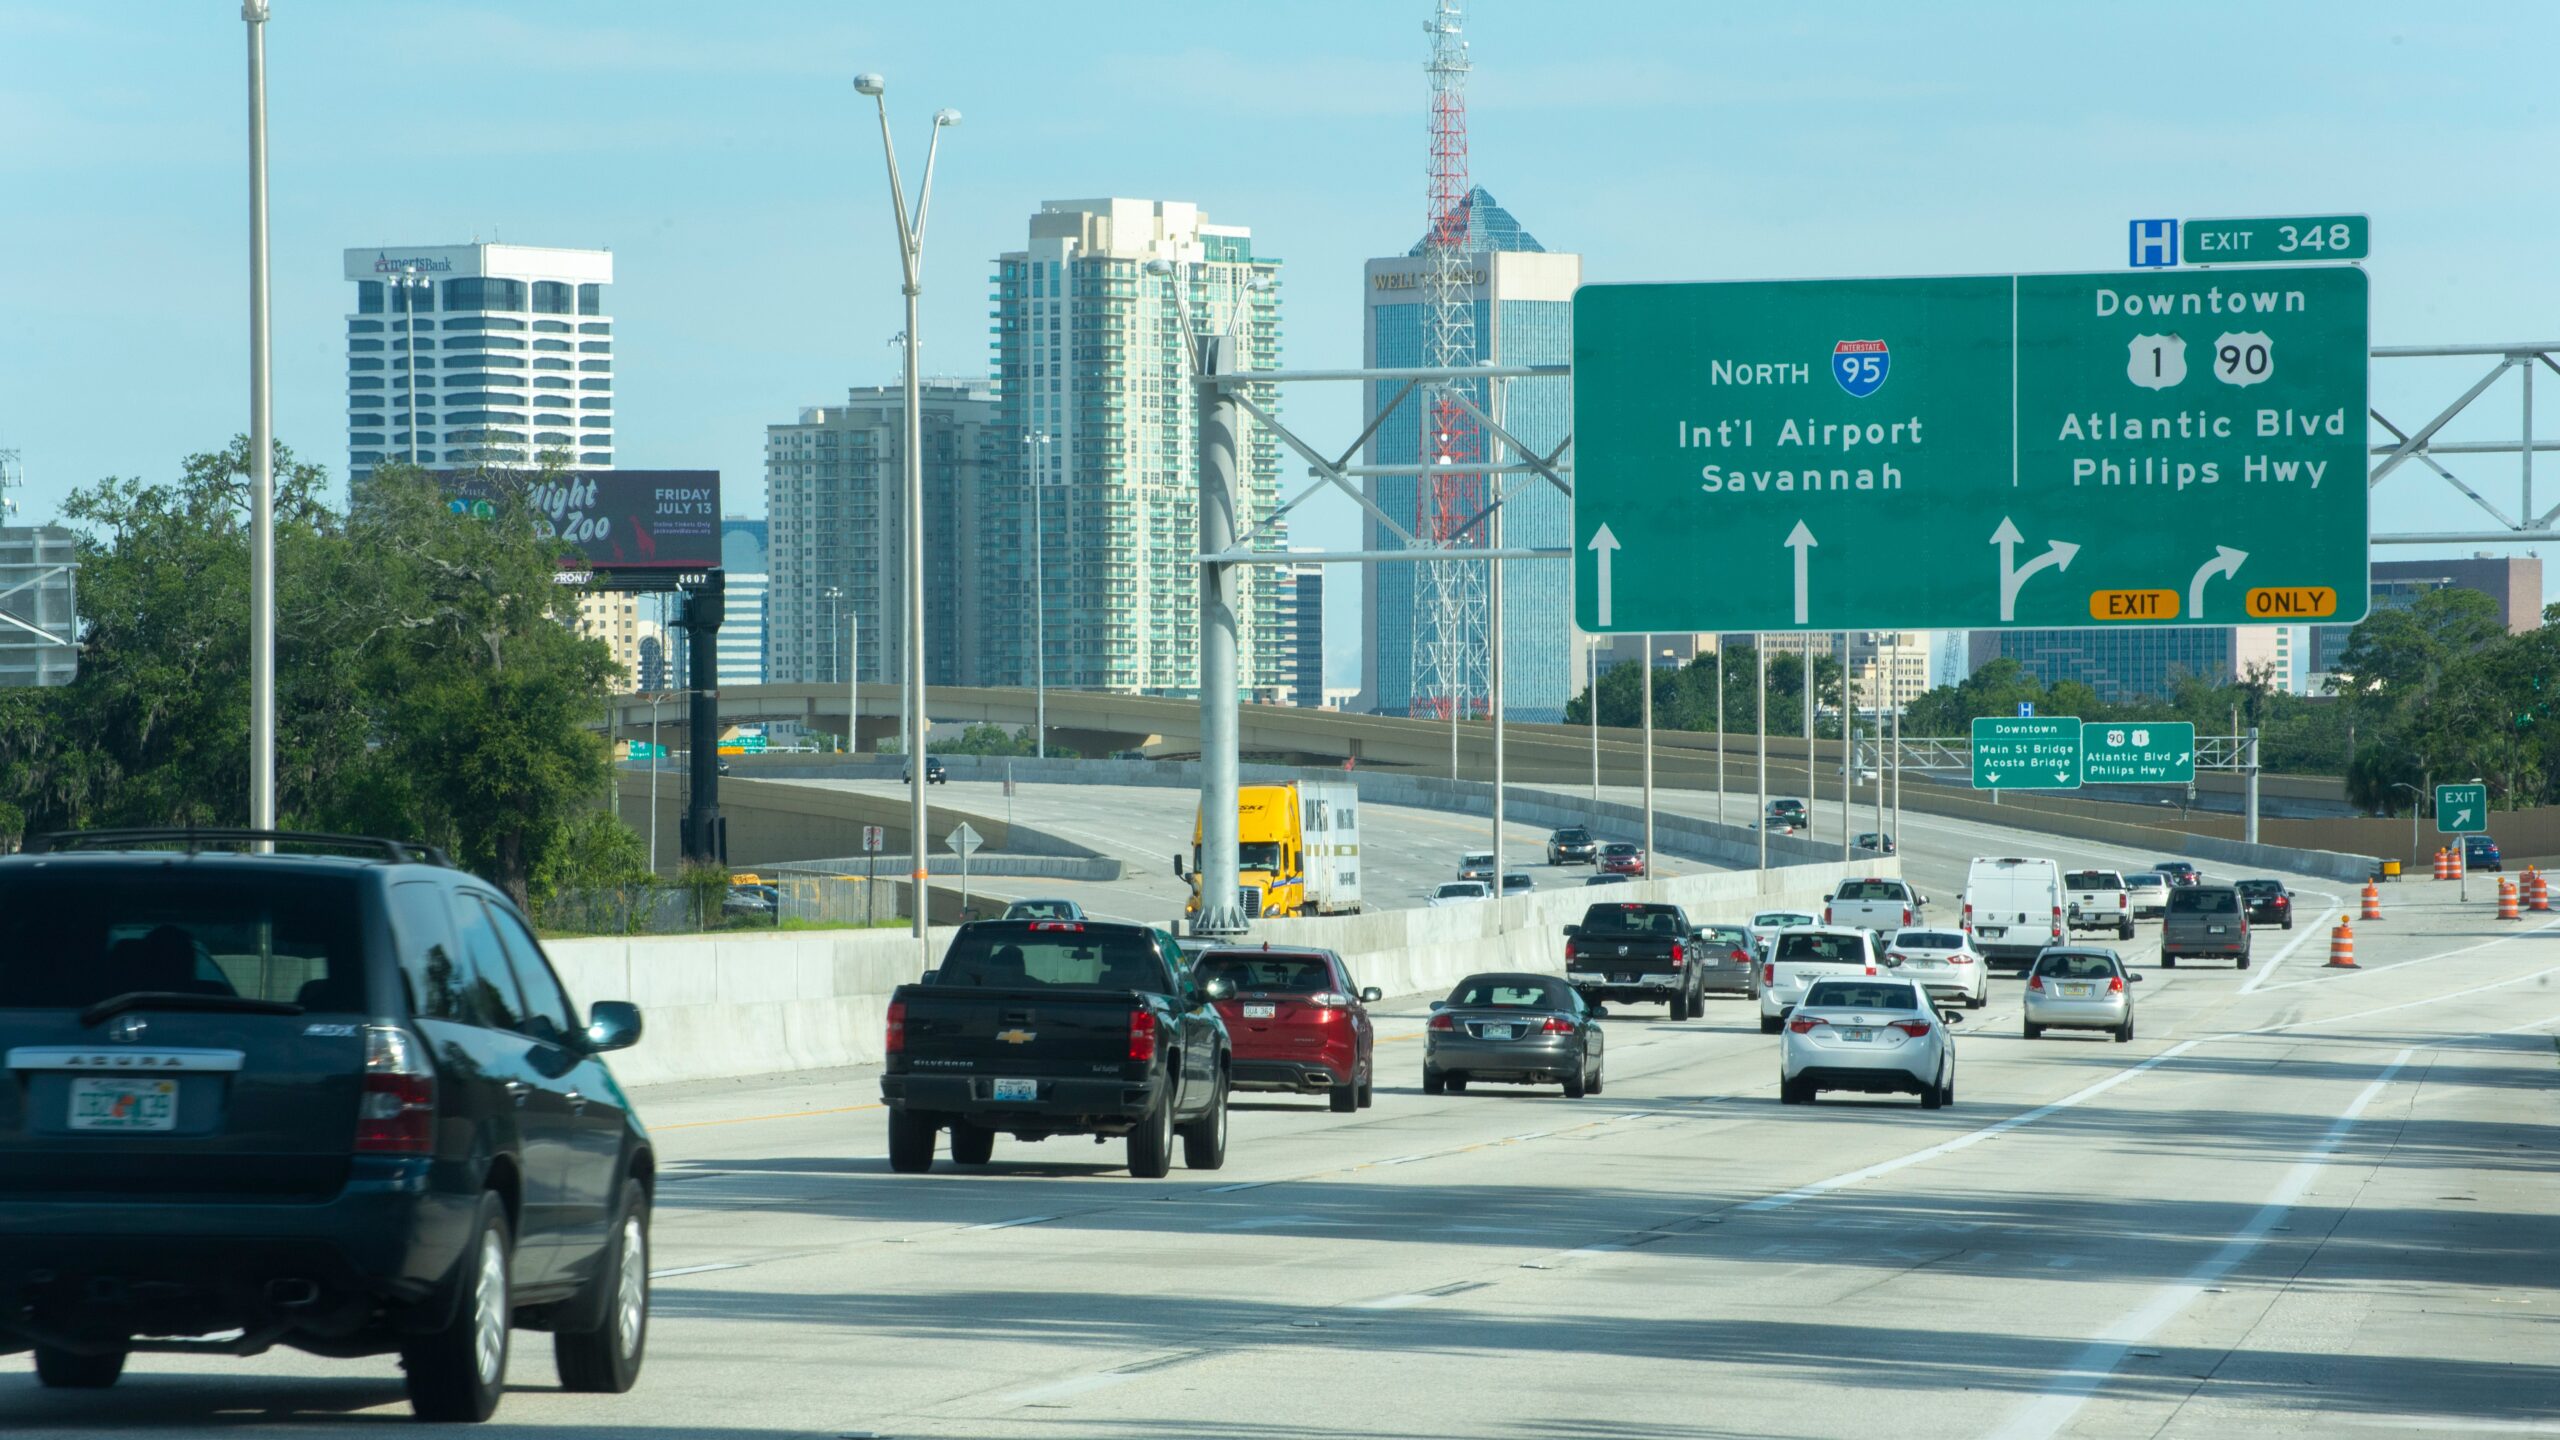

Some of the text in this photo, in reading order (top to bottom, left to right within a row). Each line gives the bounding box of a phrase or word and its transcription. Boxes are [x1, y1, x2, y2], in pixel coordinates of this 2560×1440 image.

[2137, 222, 2170, 263] H
[2201, 224, 2349, 252] EXIT 348
[2097, 287, 2304, 316] Downtown
[1841, 343, 1881, 352] INTERSTATE
[2151, 345, 2267, 378] 1 90
[1712, 358, 1880, 385] NORTH 95
[2059, 408, 2343, 440] Atlantic Blvd
[1680, 417, 1921, 451] Int'l Airport
[1702, 463, 1901, 492] Savannah
[2074, 455, 2327, 490] Philips Hwy
[655, 488, 711, 500] FRIDAY
[655, 502, 713, 514] JULY 13
[563, 511, 610, 543] Zoo
[679, 574, 707, 584] 5607
[2110, 592, 2324, 615] EXIT ONLY
[2020, 703, 2031, 716] H
[1996, 725, 2056, 733] Downtown
[2109, 734, 2123, 743] 90
[1980, 745, 2073, 755] Main St Bridge
[2087, 752, 2170, 761] Atlantic Blvd
[1985, 758, 2070, 768] Acosta Bridge
[2091, 766, 2165, 776] Philips Hwy
[2445, 792, 2476, 803] EXIT
[66, 1056, 182, 1066] ACURA
[998, 1085, 1013, 1096] 578
